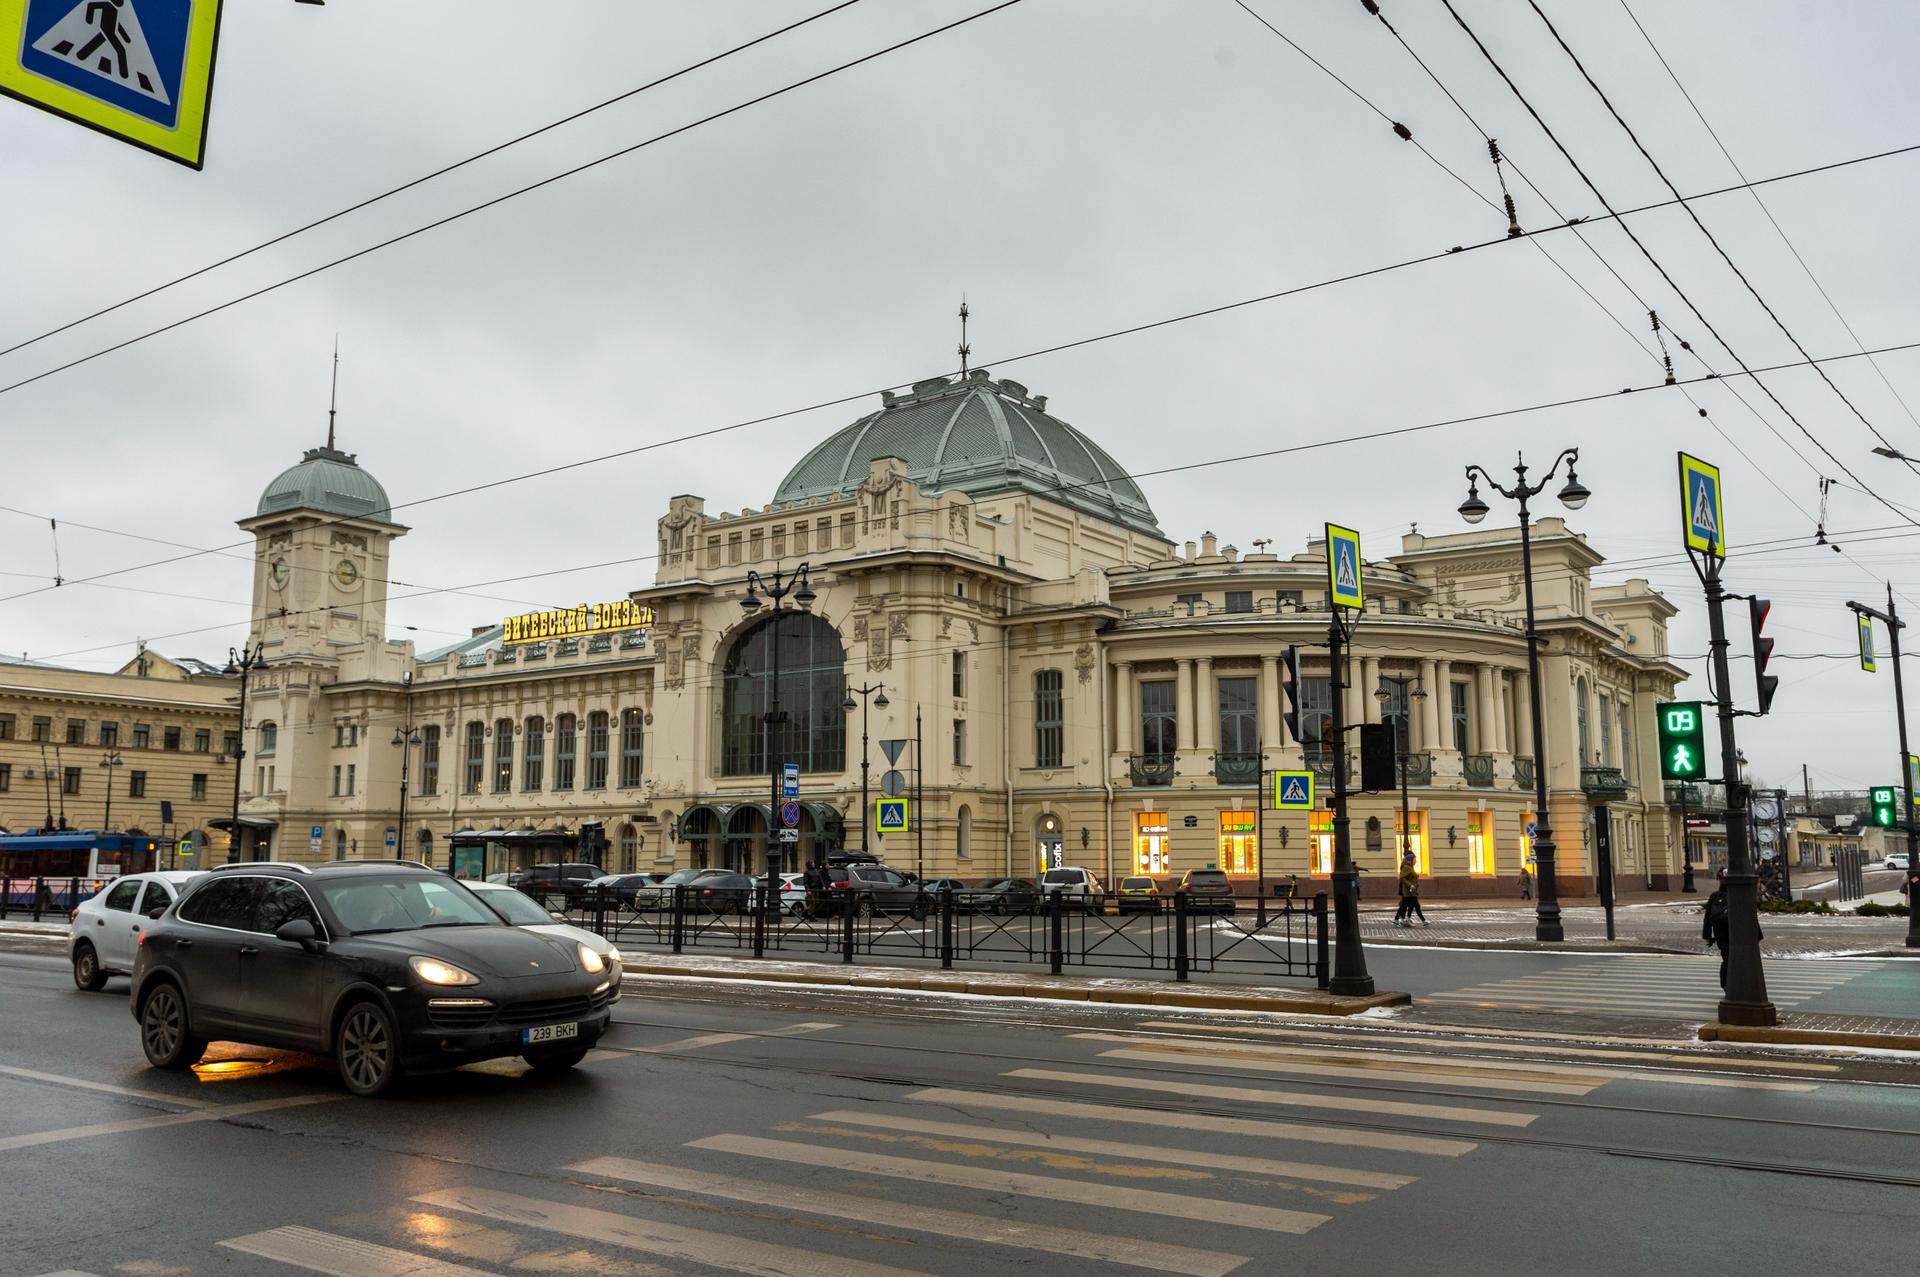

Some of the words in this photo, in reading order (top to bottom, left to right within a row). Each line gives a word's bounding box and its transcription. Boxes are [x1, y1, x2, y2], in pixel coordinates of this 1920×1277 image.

[503, 603, 588, 641] ВИТЕБСКИЙ
[593, 600, 653, 630] ВОКЗАЛ
[1668, 711, 1693, 731] 09
[533, 1028, 551, 1041] 239
[556, 1024, 576, 1037] BKH
